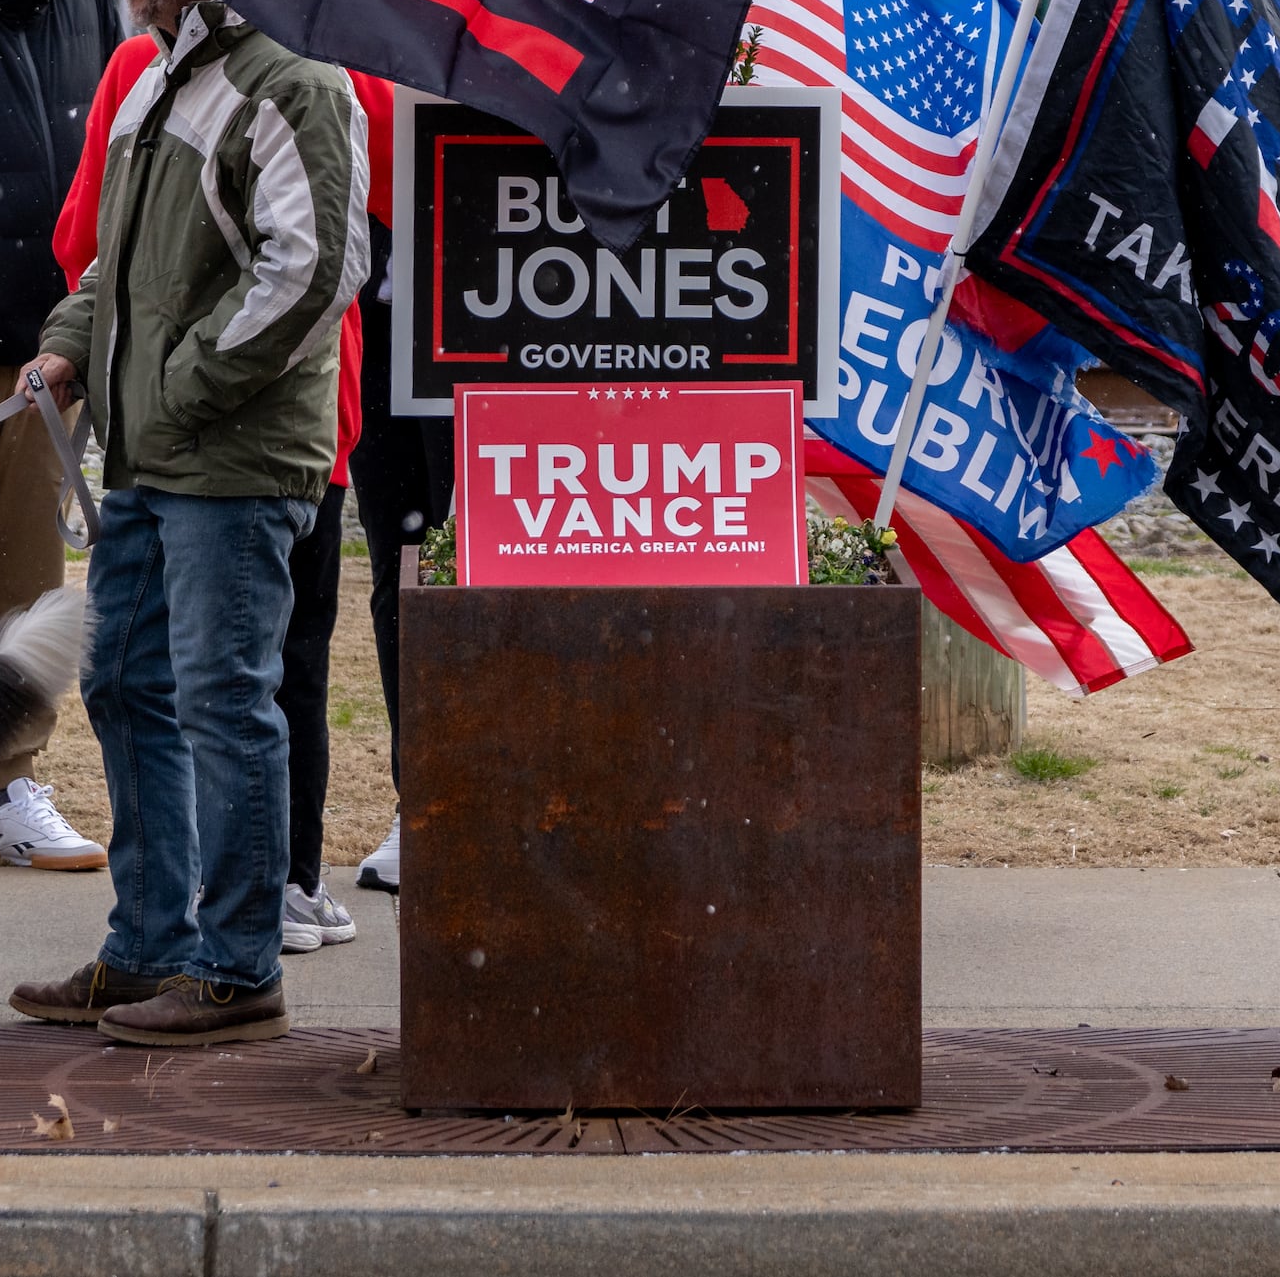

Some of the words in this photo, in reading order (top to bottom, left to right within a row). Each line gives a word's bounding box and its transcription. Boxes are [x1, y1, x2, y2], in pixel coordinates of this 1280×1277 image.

[1083, 193, 1199, 308] TAK
[463, 246, 769, 320] JONES
[519, 343, 711, 370] GOVERNOR
[478, 442, 782, 495] TRUMP
[513, 496, 748, 538] VANCE
[498, 542, 548, 555] MAKE
[554, 542, 634, 554] AMERICA
[640, 541, 697, 554] GREAT
[703, 540, 766, 553] AGAIN!
